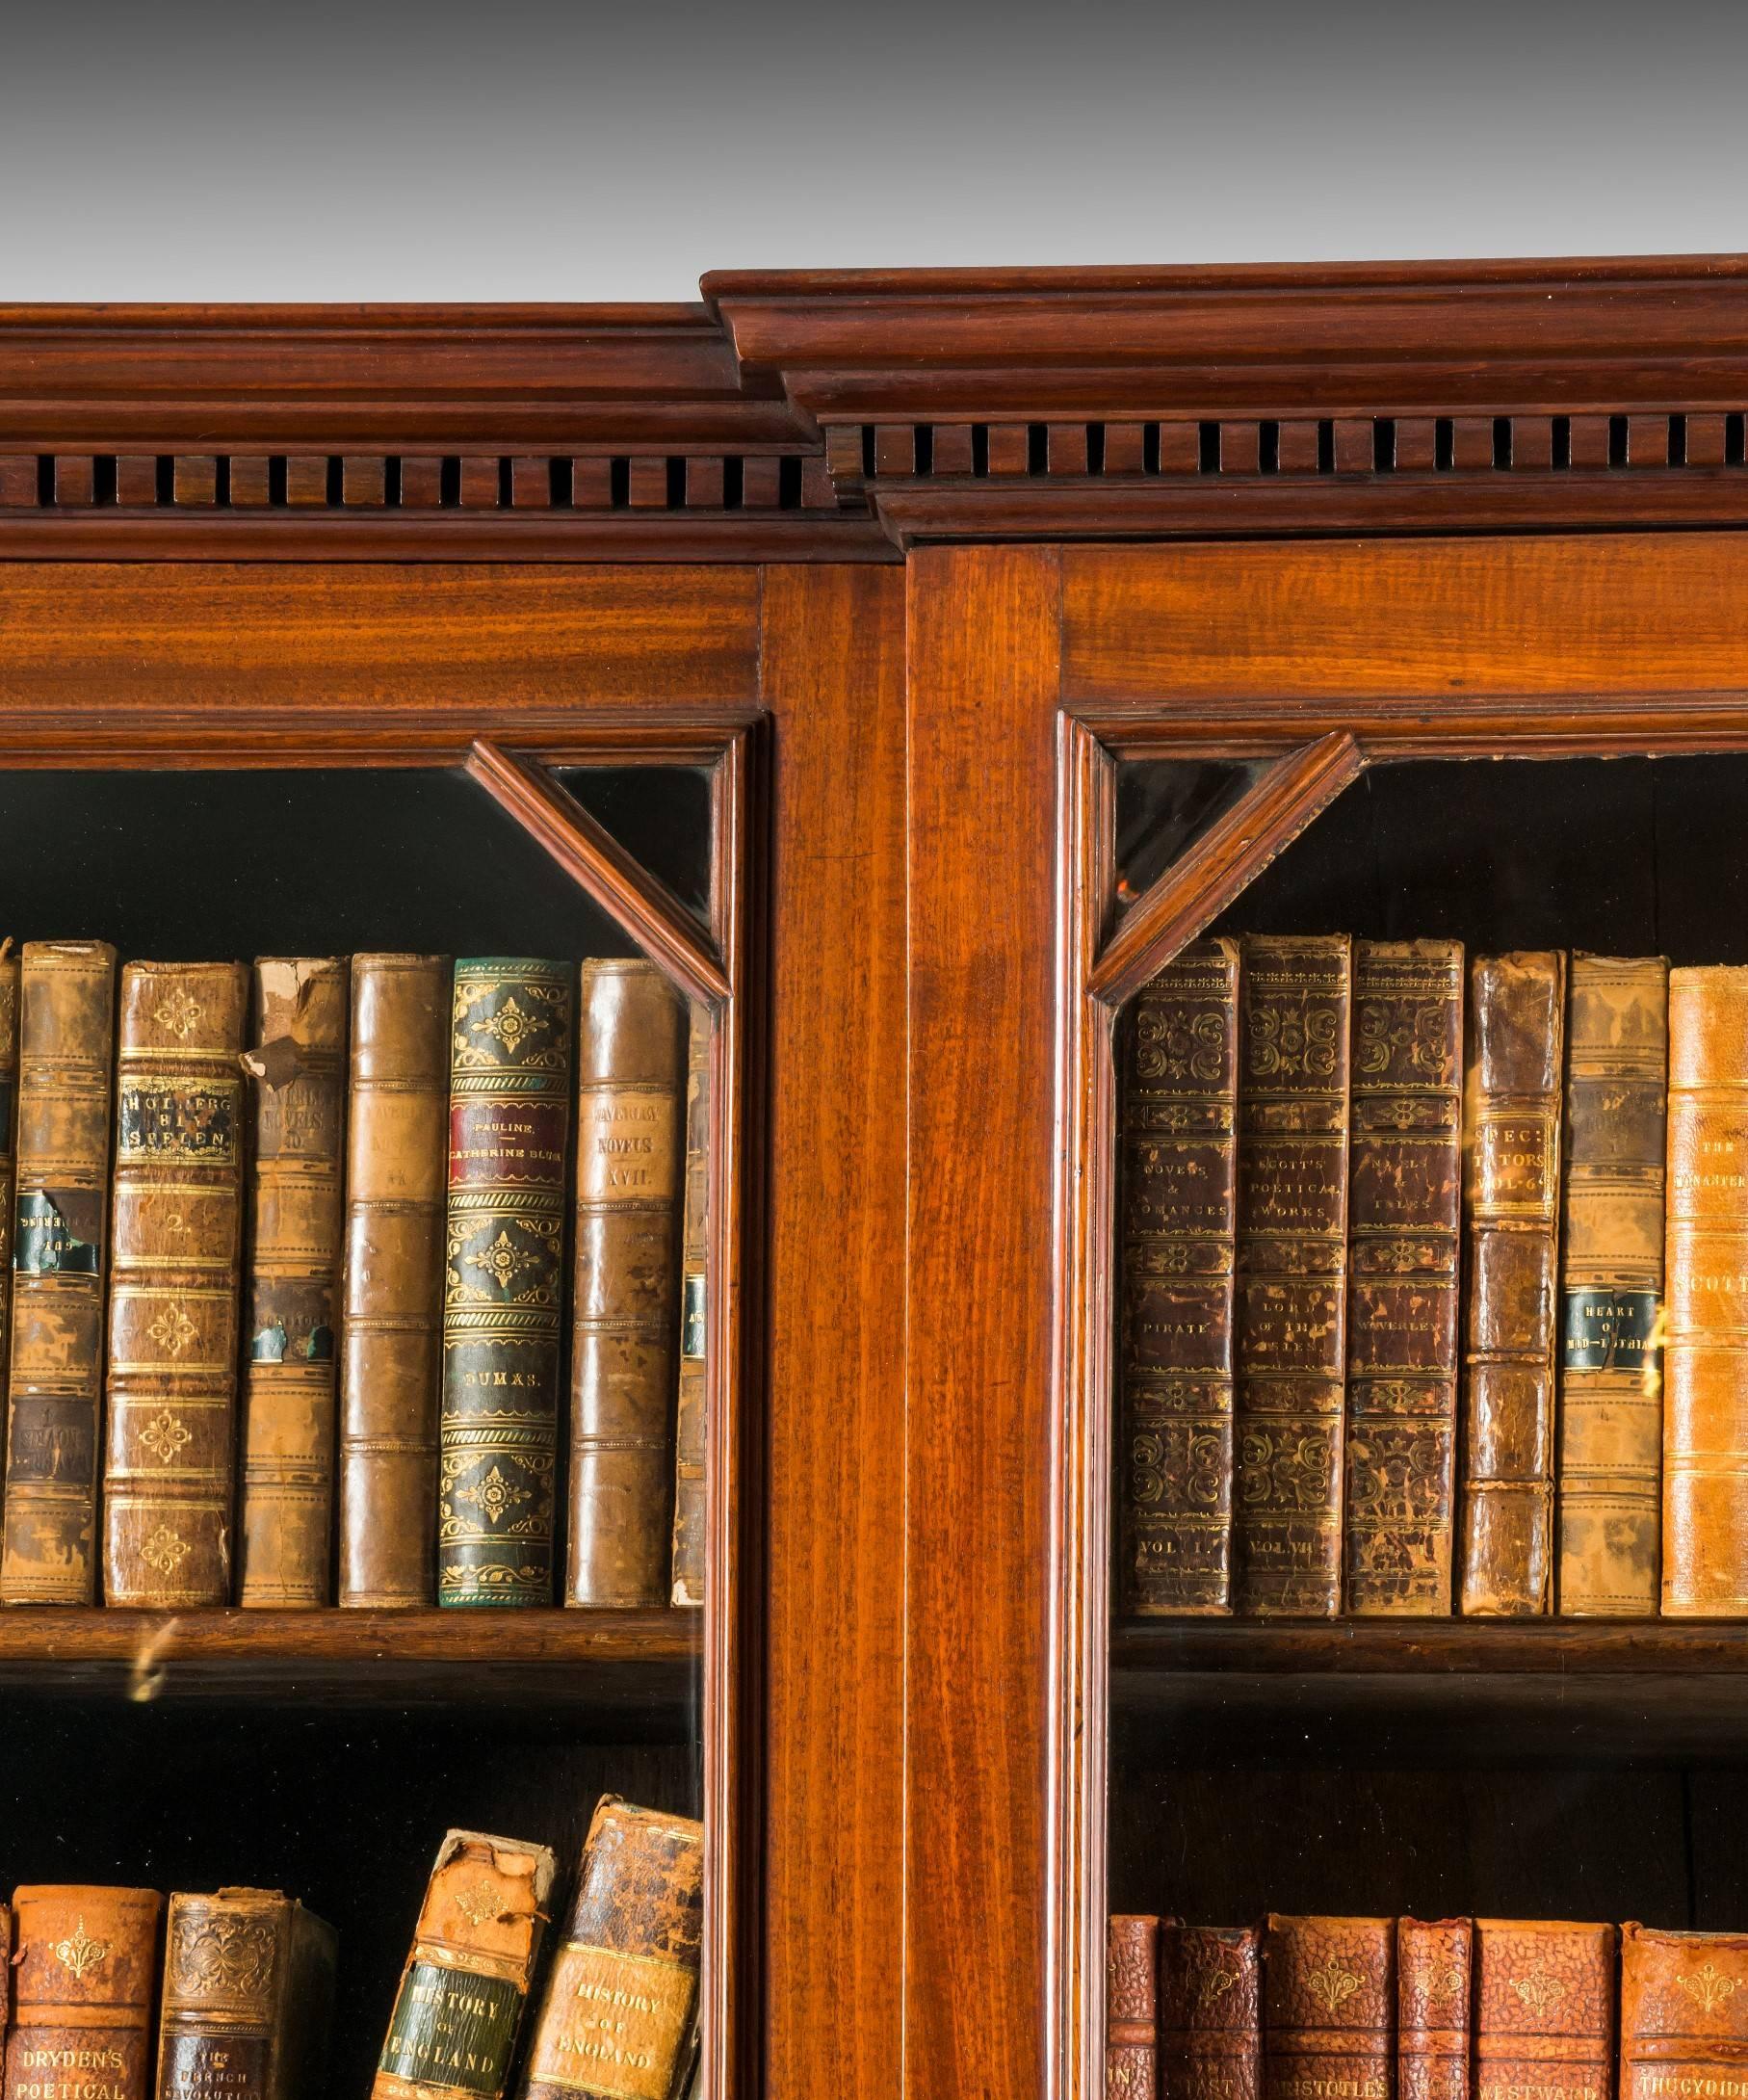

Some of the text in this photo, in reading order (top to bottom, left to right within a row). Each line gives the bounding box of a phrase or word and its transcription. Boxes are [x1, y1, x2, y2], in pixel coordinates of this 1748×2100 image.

[1702, 1141, 1734, 1153] THE
[449, 1148, 525, 1160] CATHERINE
[1259, 1160, 1325, 1170] SCOTT'S
[1250, 1184, 1342, 1195] POETICAL
[1130, 1205, 1228, 1217] OMANCES
[1261, 1206, 1326, 1219] WORKS
[44, 1240, 73, 1251] GUY
[1584, 1306, 1634, 1318] HEART
[412, 1984, 501, 2020] HISTORY
[578, 1982, 662, 2014] HISTORY
[436, 2022, 456, 2035] OF
[390, 2035, 494, 2073] ENGLAND
[558, 2034, 652, 2069] ENGLAND
[22, 2050, 124, 2068] DRYDEN'S
[16, 2083, 126, 2100] POETICAL
